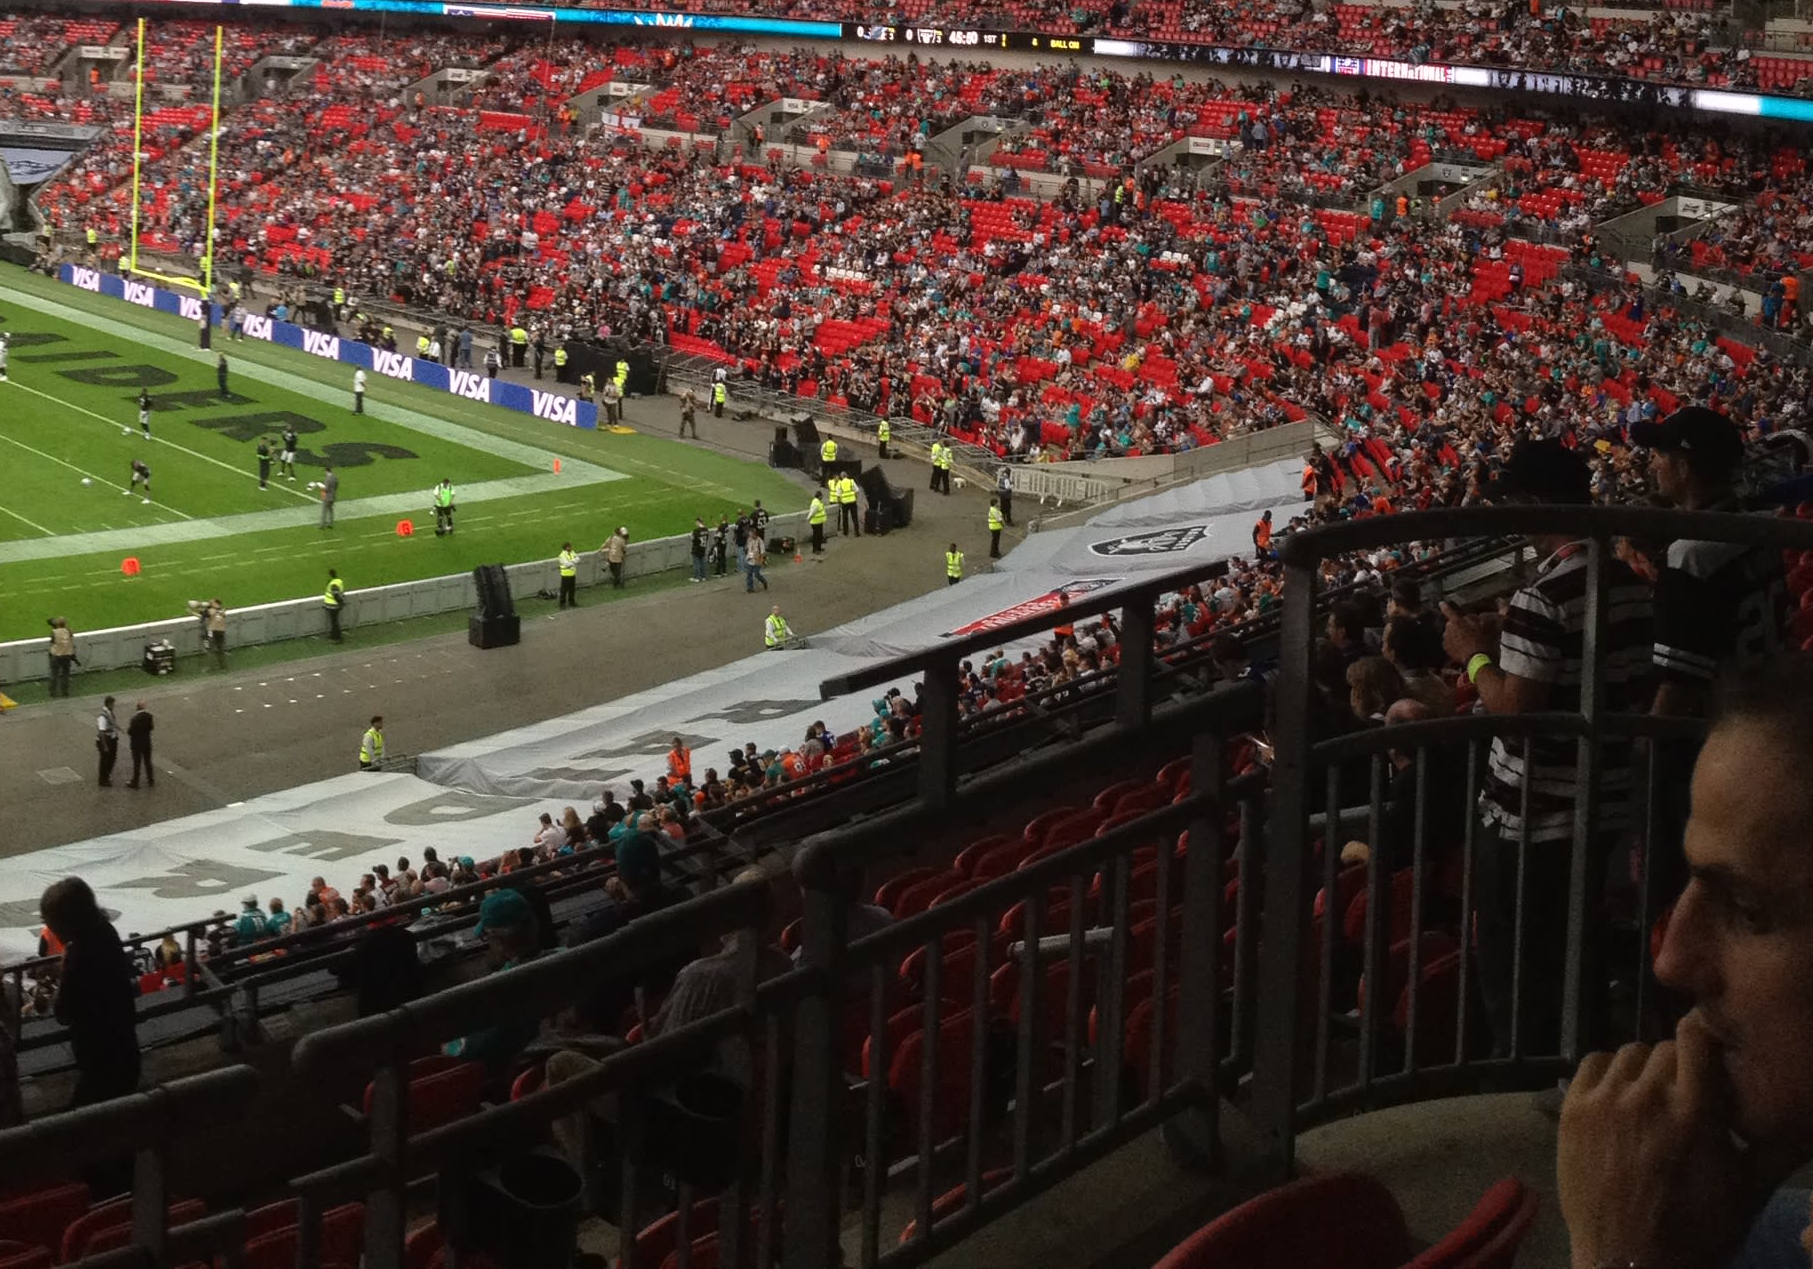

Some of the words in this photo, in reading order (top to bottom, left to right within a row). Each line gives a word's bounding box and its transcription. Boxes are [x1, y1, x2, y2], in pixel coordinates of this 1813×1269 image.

[906, 29, 913, 40] 0
[984, 34, 997, 44] 1ST
[1050, 39, 1066, 48] BALL
[1067, 41, 1080, 49] ON
[1366, 59, 1447, 82] INTERNATIONAL
[72, 265, 100, 293] VISA
[123, 280, 155, 308] VISA
[179, 295, 203, 321] VIS
[303, 328, 339, 361] VISA
[373, 347, 414, 381] VISA
[449, 368, 490, 402] VISA
[531, 389, 577, 425] VISA
